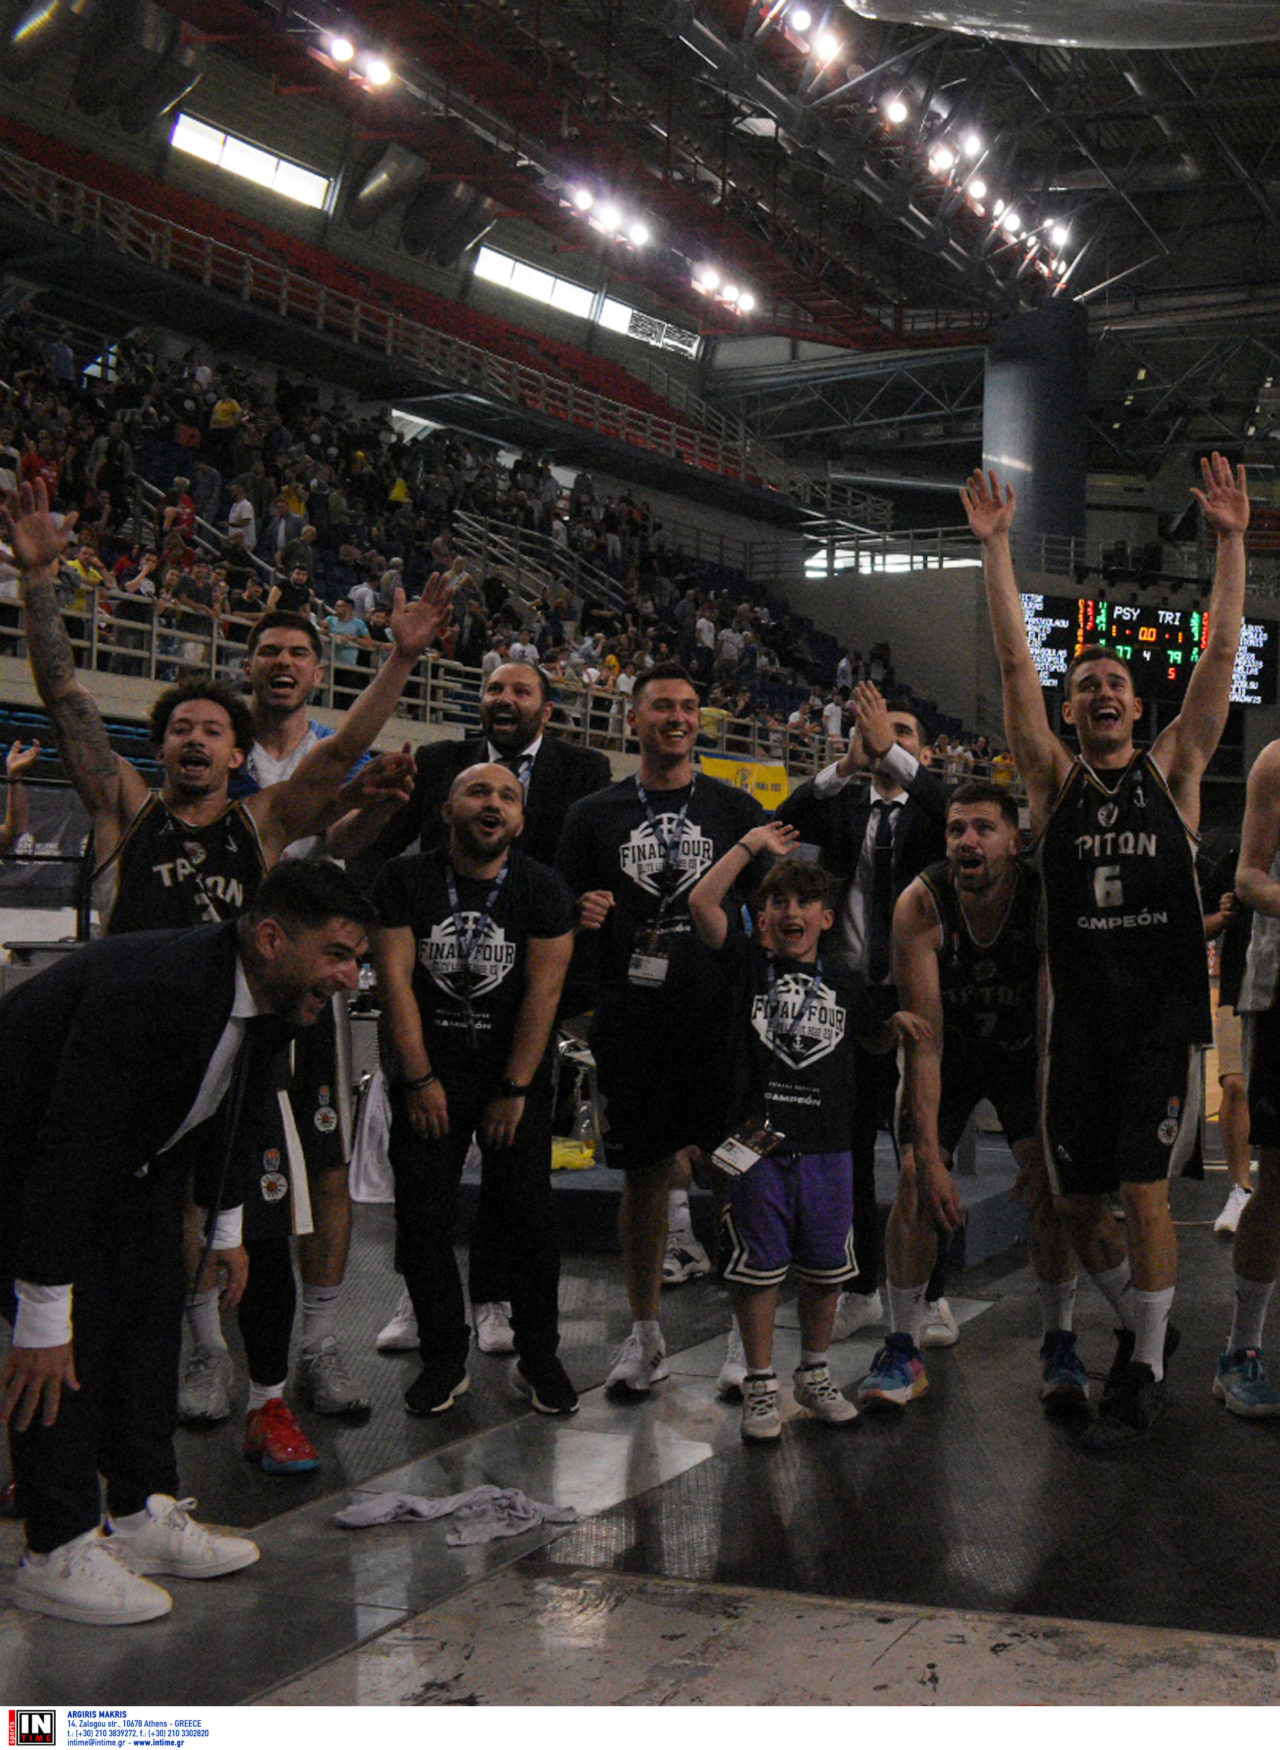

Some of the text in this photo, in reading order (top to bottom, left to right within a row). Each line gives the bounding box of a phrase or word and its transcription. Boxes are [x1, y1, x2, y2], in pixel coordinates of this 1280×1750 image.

[1113, 606, 1182, 625] PSY TRI
[1115, 645, 1133, 660] 77
[1143, 650, 1152, 662] 4
[1167, 650, 1183, 664] 79
[1168, 667, 1177, 680] 5
[681, 839, 713, 861] OUR
[1094, 864, 1124, 908] 6
[419, 941, 514, 964] FINAL FOUR
[752, 998, 799, 1019] FIAL
[808, 1006, 844, 1032] FOUR
[764, 1092, 822, 1106] CAMPEÓN
